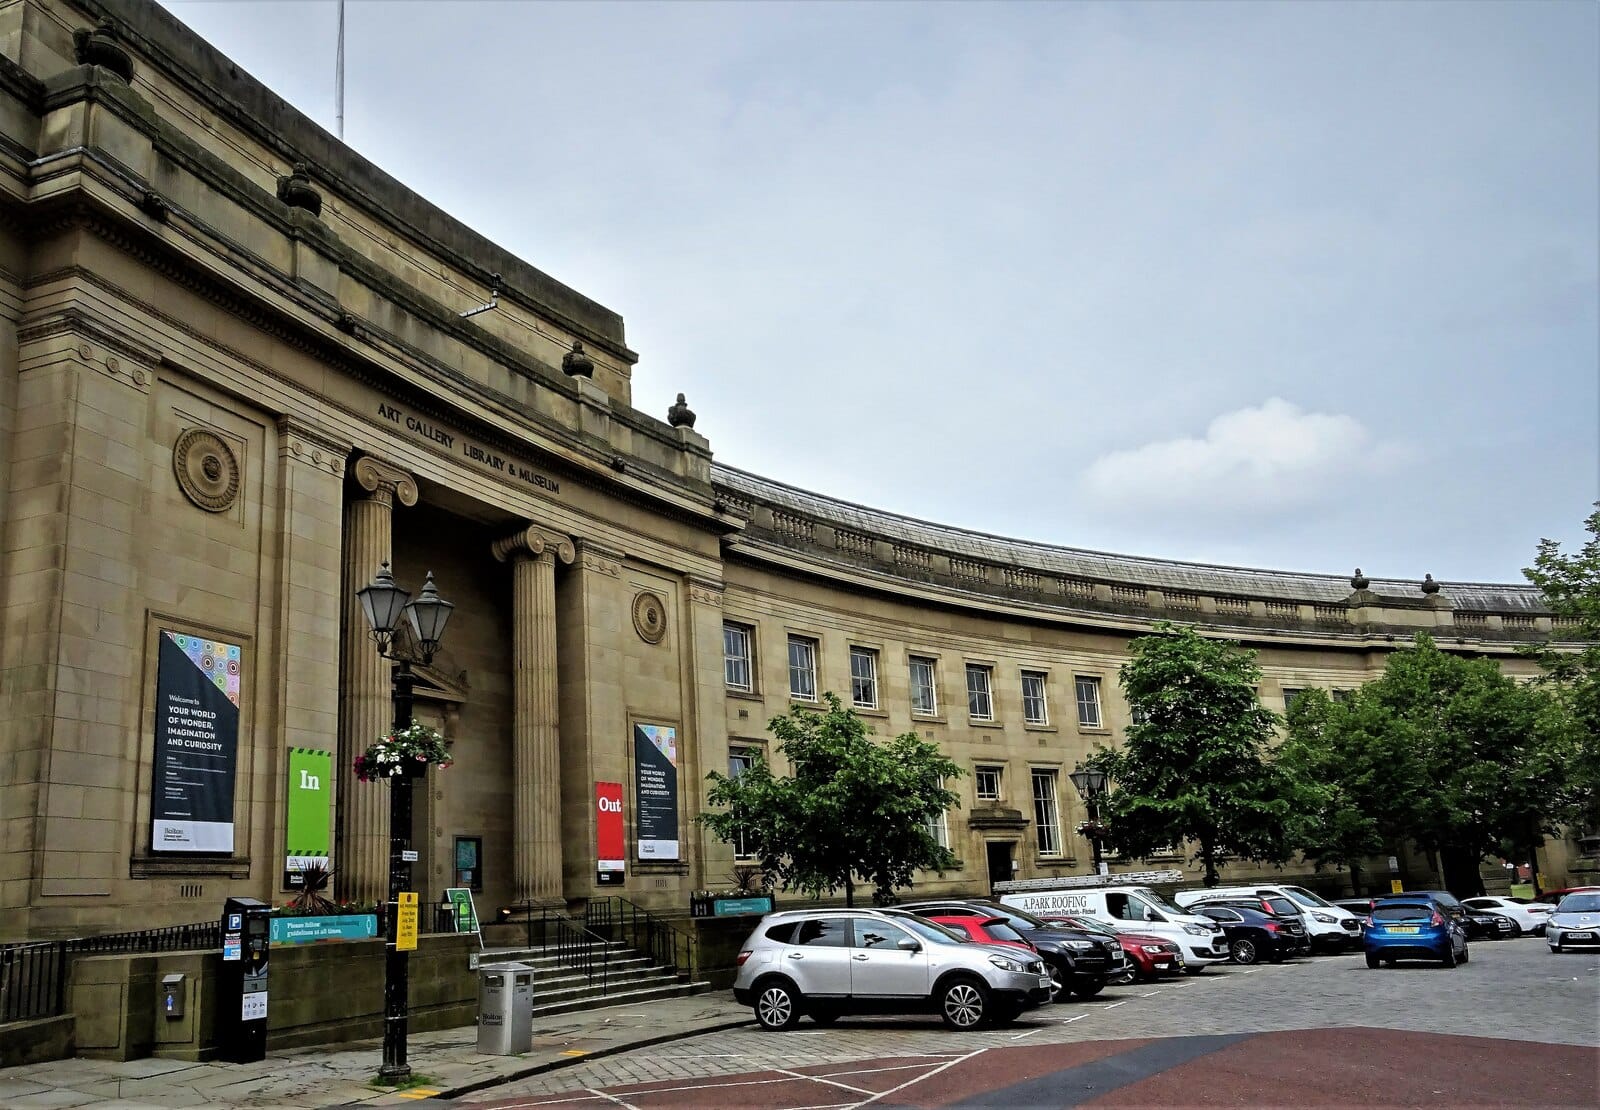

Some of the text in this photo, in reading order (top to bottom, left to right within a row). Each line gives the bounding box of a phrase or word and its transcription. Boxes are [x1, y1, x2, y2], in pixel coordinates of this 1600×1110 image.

[378, 403, 560, 495] ART GALLERY LIBRARY & MUSEUM
[168, 694, 194, 705] Welcome
[168, 705, 217, 720] YOUR WORLD
[168, 716, 214, 731] OF WONDER,
[167, 727, 216, 740] IMAGINATION
[167, 738, 223, 752] AND CURIOSITY
[300, 769, 320, 790] In
[598, 796, 622, 813] Out
[1052, 895, 1087, 909] ROOFING
[231, 916, 239, 927] P
[482, 1012, 503, 1020] Bolton
